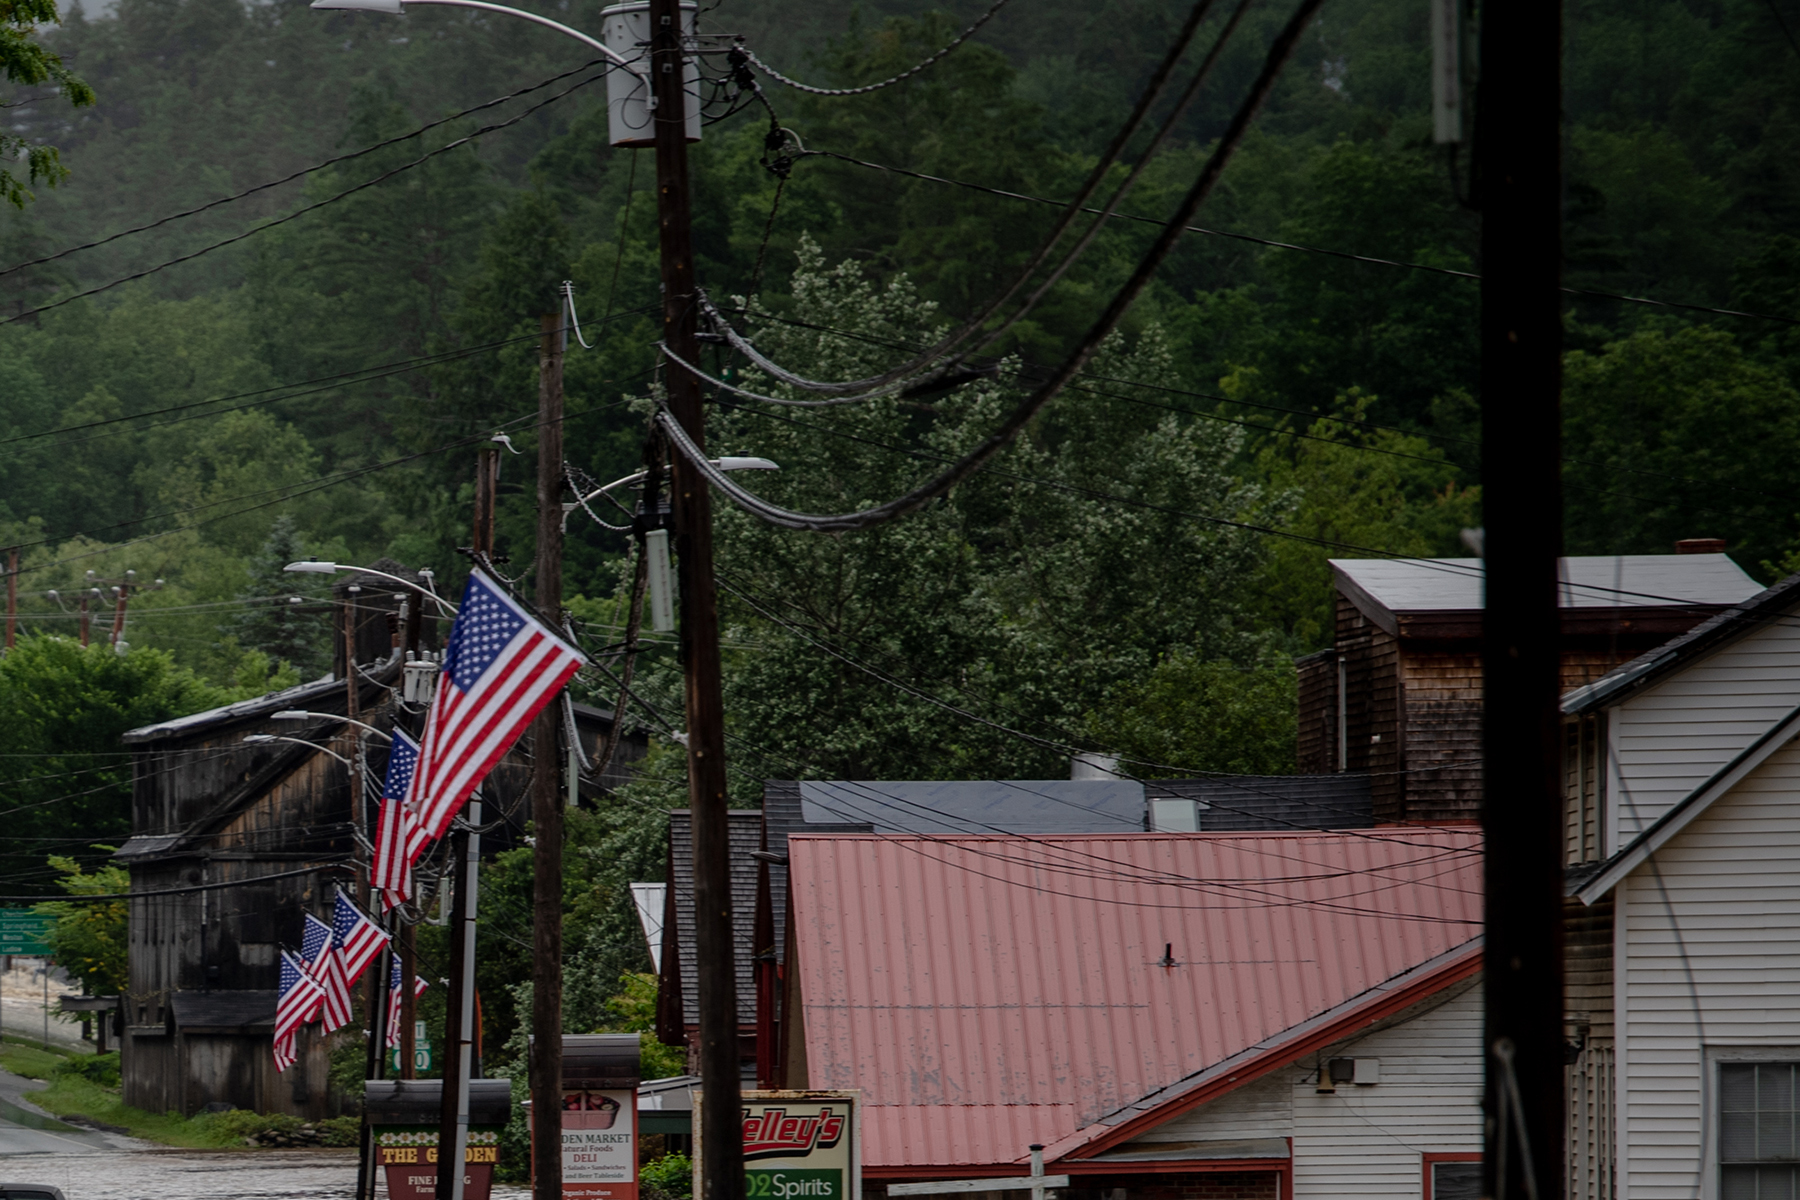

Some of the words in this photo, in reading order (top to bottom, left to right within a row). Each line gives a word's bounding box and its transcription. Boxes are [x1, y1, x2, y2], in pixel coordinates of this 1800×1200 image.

[741, 1108, 844, 1152] elley's
[561, 1134, 582, 1143] DEN
[585, 1134, 630, 1143] MARKET
[382, 1148, 418, 1164] THE
[426, 1147, 497, 1163] GDEN
[573, 1154, 597, 1162] DELI
[408, 1175, 432, 1185] FINE
